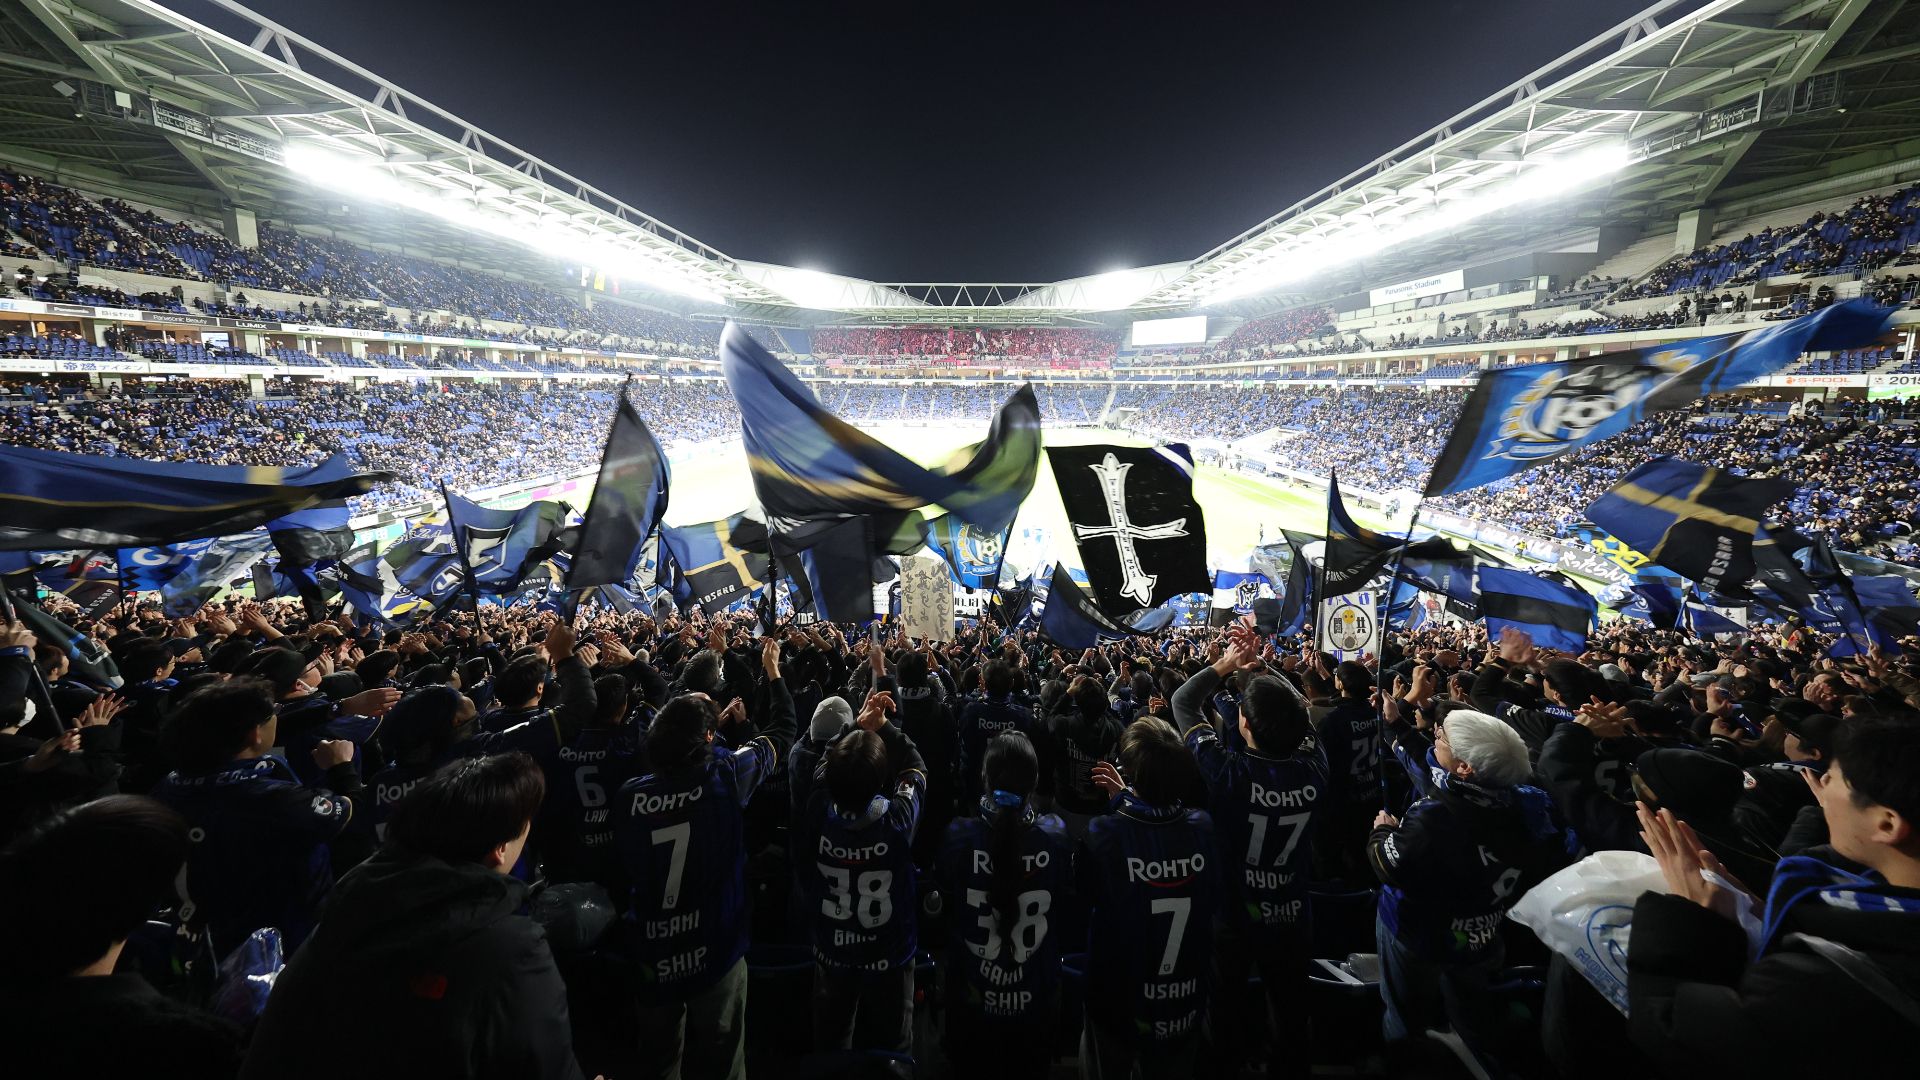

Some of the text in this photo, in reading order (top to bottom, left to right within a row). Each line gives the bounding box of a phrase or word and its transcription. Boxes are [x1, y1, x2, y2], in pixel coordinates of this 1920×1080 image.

[1385, 278, 1441, 295] Panasonic Stadium
[153, 314, 185, 323] Panasonic
[236, 320, 267, 329] LUMIX
[704, 584, 736, 603] OSAKA
[978, 717, 1016, 730] ROHTO
[1350, 718, 1378, 733] ROHT
[558, 746, 607, 763] ROHTO
[376, 780, 416, 806] ROH
[574, 765, 608, 808] 6
[1250, 782, 1317, 808] ROHTO
[631, 784, 703, 816] ROHTO
[819, 835, 889, 861] ROHTO
[1246, 811, 1312, 867] 17
[651, 821, 691, 911] 7
[973, 849, 1050, 875] RTO
[1127, 853, 1205, 883] ROHTO
[816, 861, 893, 929] 38
[1260, 899, 1303, 918] SHIP
[646, 909, 700, 940] USAMI
[965, 887, 1052, 964] 38
[1150, 896, 1192, 976] 7
[656, 946, 708, 977] SHIP
[984, 990, 1033, 1011] SHIP
[1144, 977, 1198, 1000] USAMI
